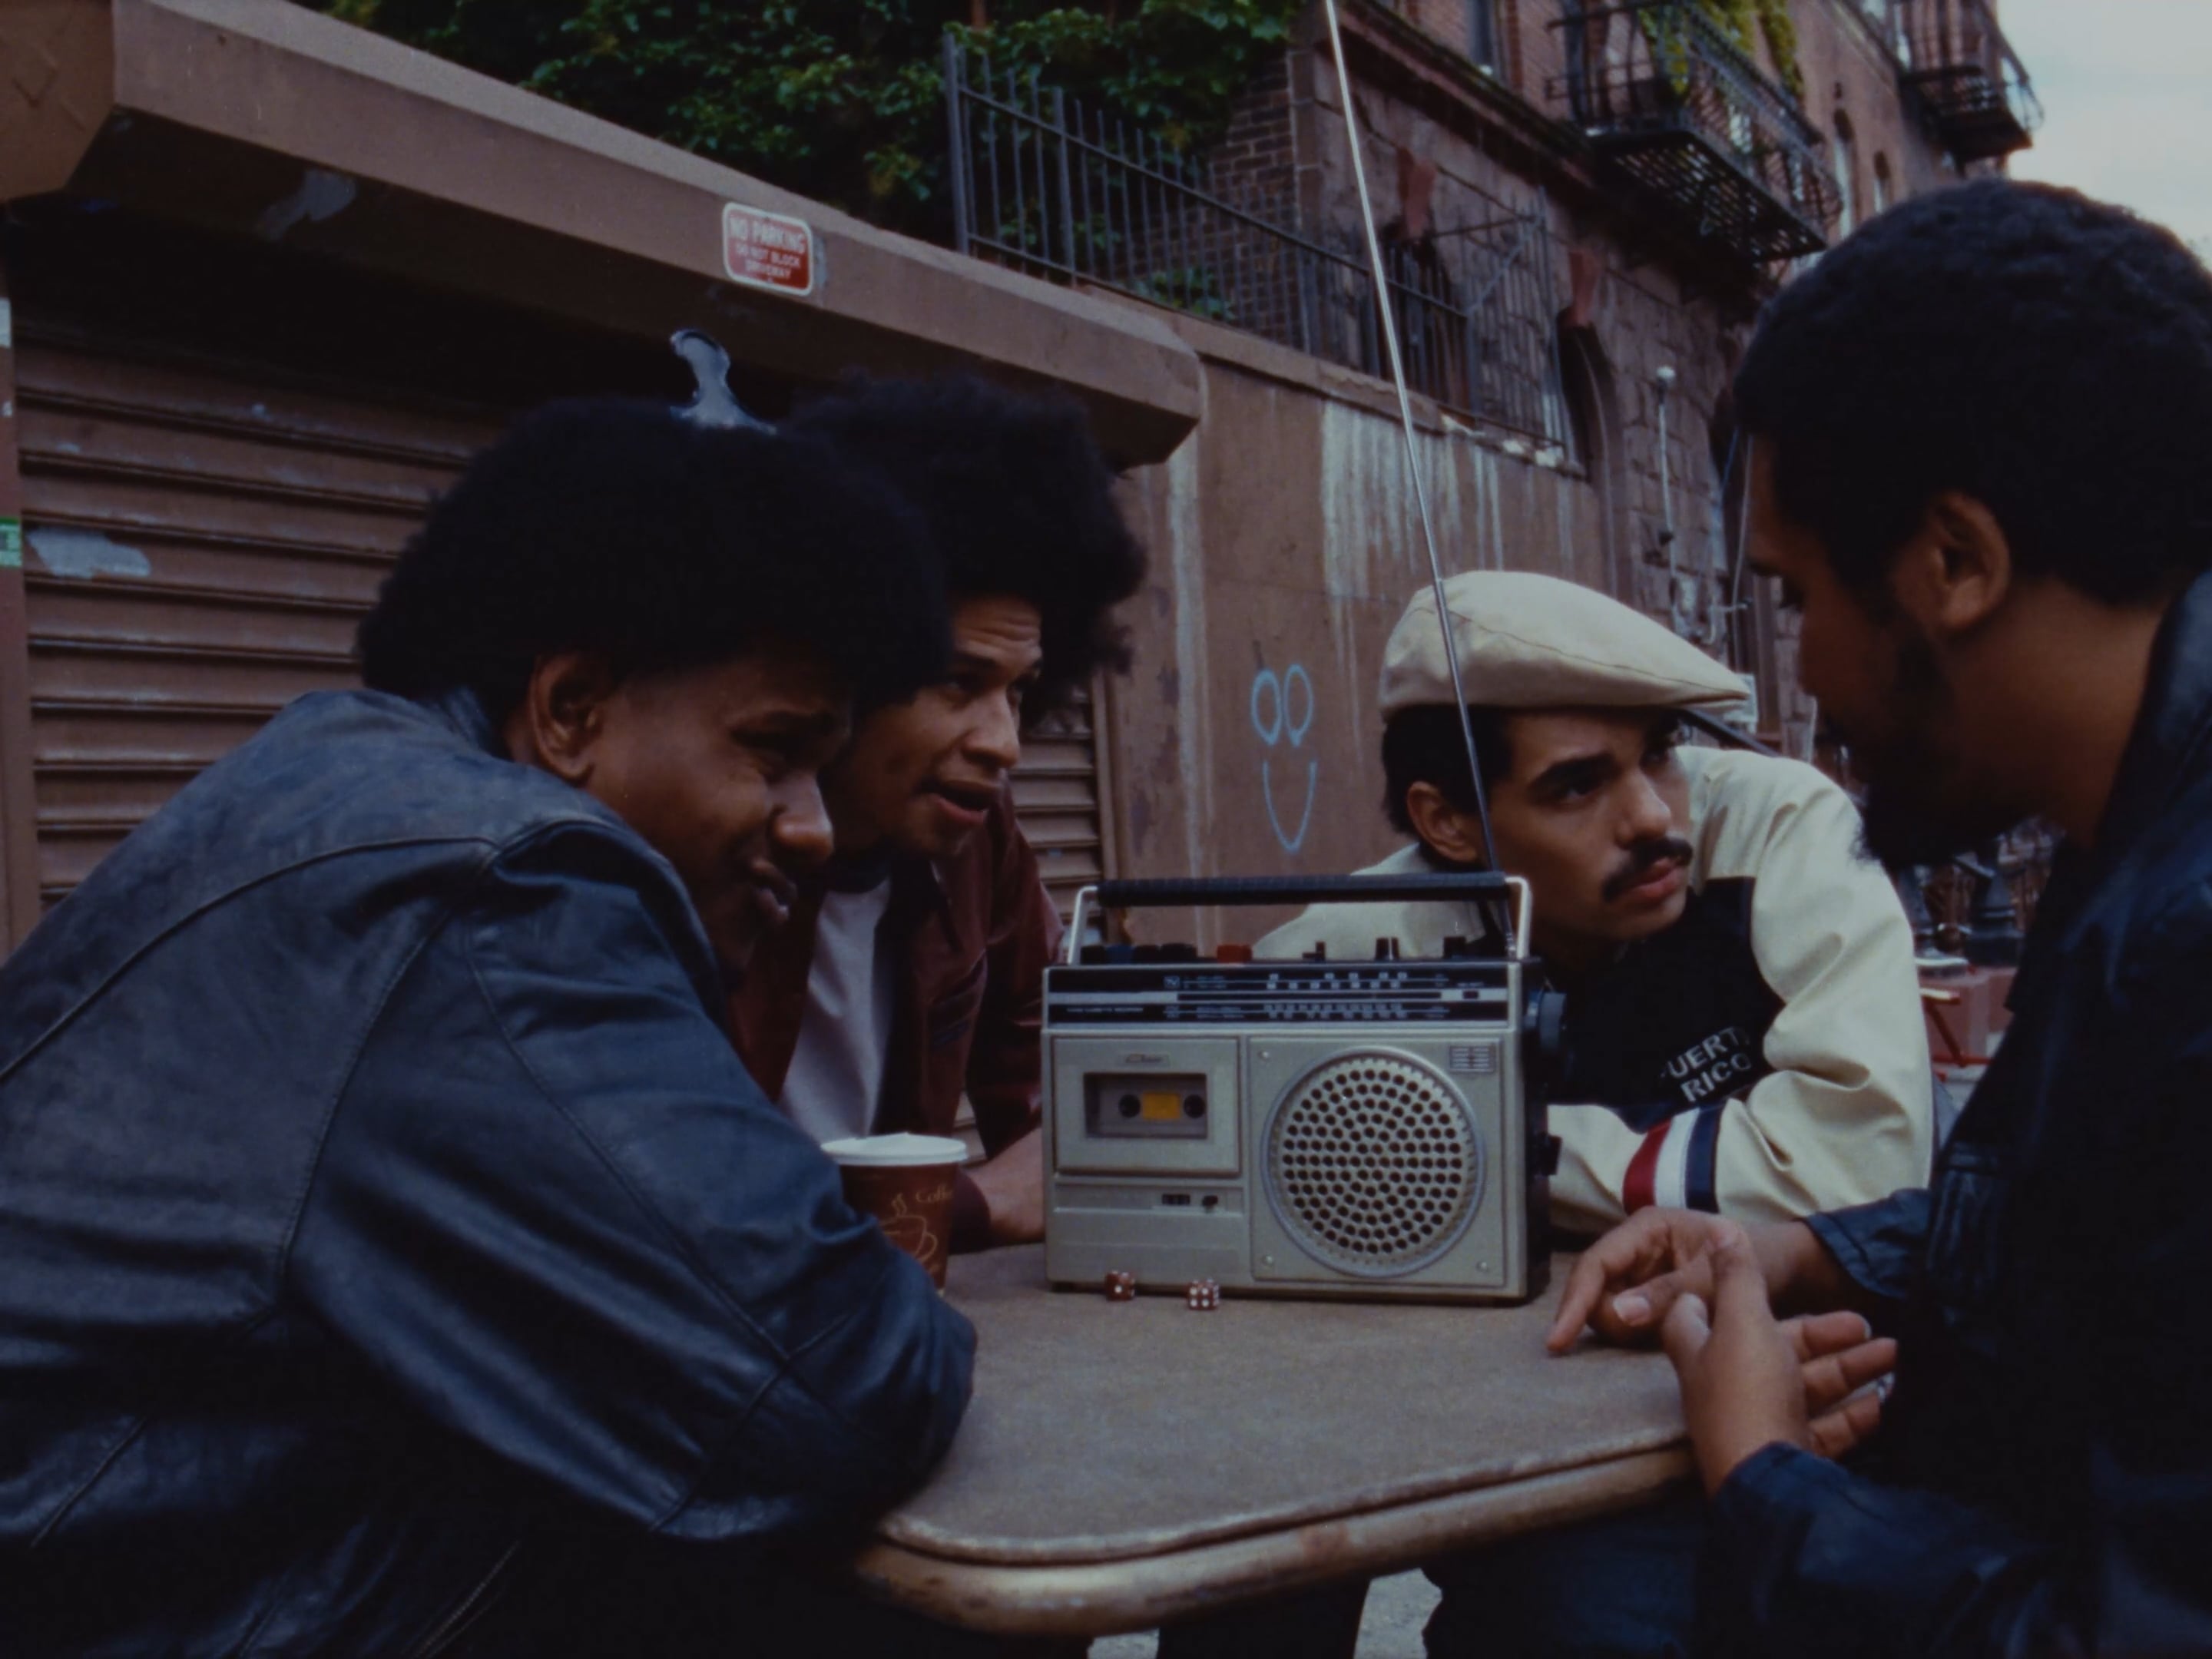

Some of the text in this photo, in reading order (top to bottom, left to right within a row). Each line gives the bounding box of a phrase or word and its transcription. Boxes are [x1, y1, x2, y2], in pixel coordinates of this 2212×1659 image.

[729, 216, 807, 254] NO PARKING
[770, 250, 801, 270] BLOCK
[1660, 1026, 1750, 1079] UERT
[1679, 1051, 1753, 1103] RICO
